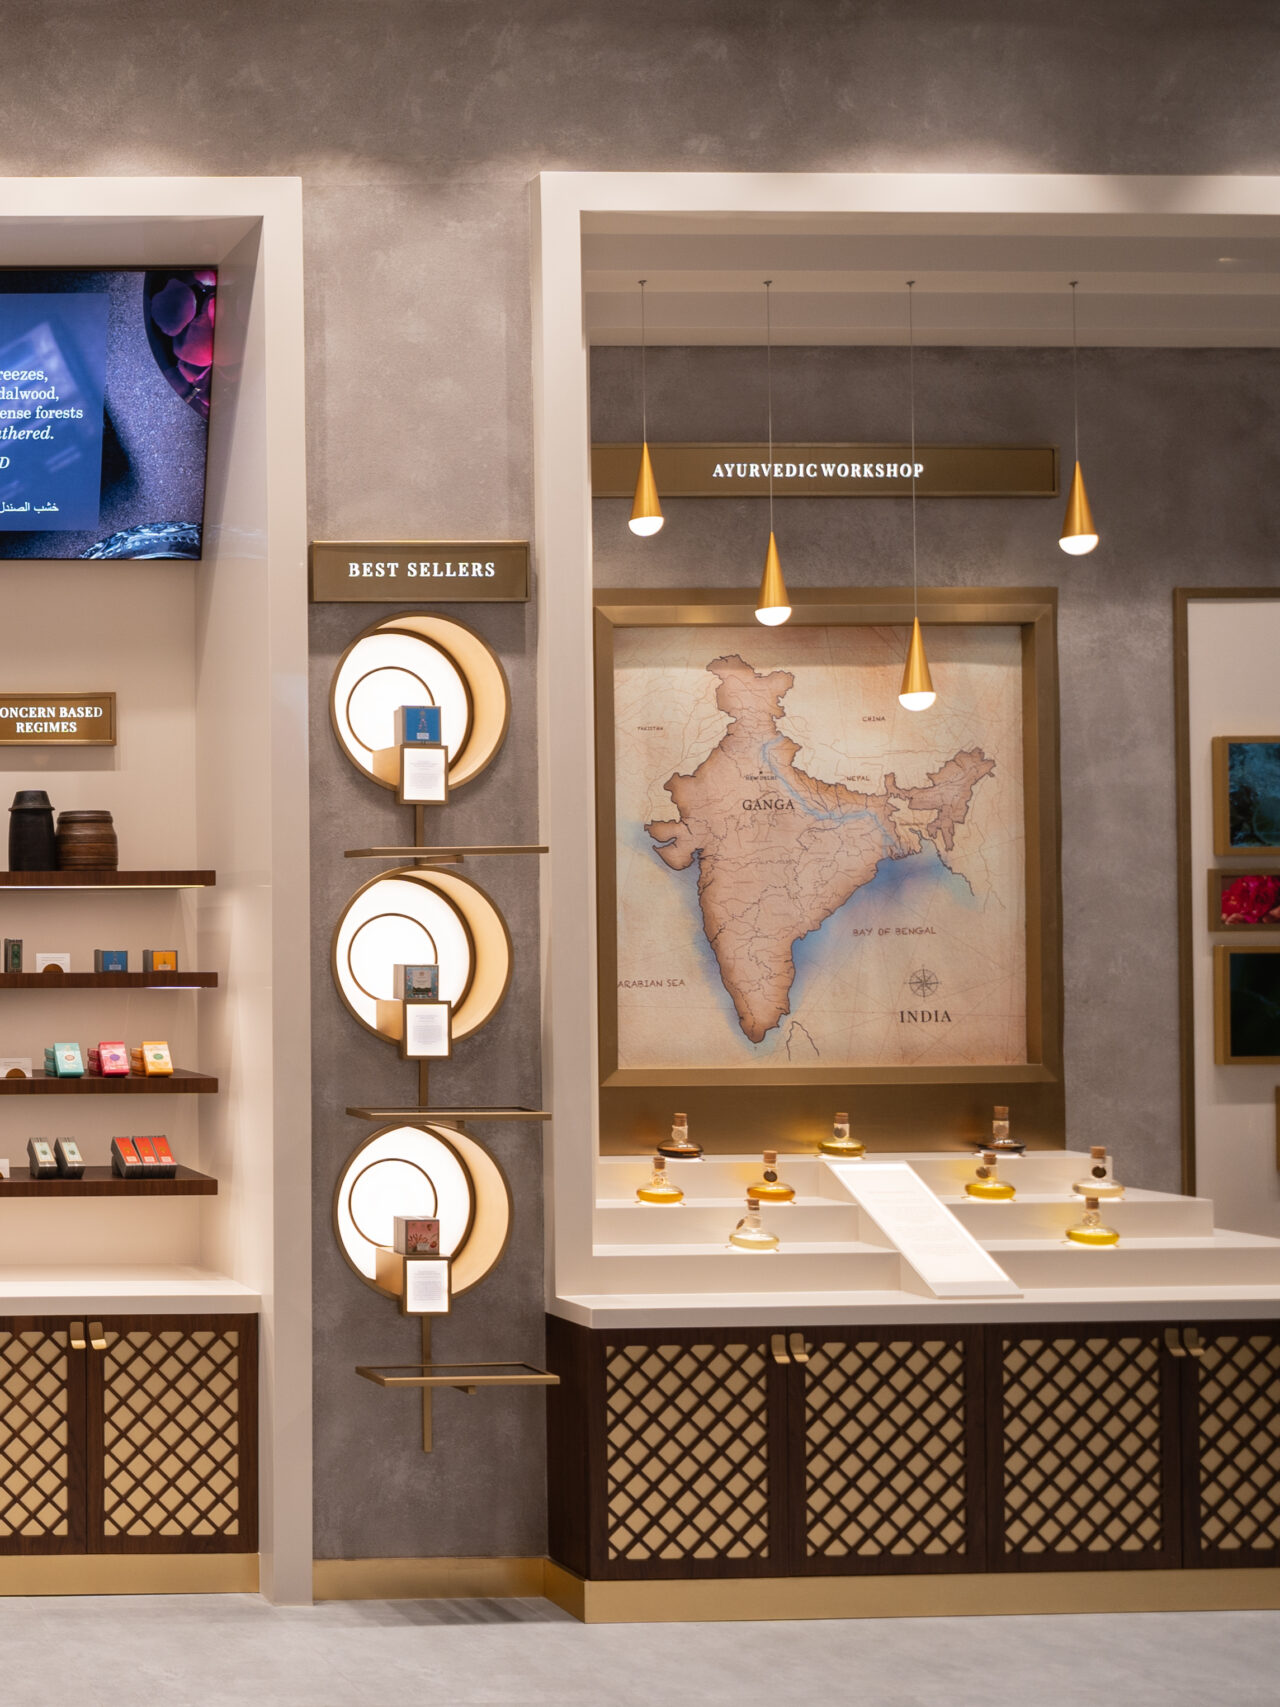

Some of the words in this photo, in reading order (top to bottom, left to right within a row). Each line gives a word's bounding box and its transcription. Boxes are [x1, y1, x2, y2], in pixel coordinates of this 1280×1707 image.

[35, 406, 84, 420] forests
[712, 463, 818, 478] AYURVEDIC
[821, 463, 924, 478] WORKSHOP
[33, 502, 59, 515] خشب
[348, 562, 399, 577] BEST
[407, 562, 496, 577] SELLERS
[59, 706, 103, 718] BASED
[15, 721, 77, 733] REGIMES
[742, 799, 795, 811] GANGA
[852, 927, 874, 937] BAY
[878, 927, 891, 936] OF
[895, 926, 937, 936] BENGAL
[666, 979, 686, 988] SEA
[899, 1009, 952, 1023] INDIA
